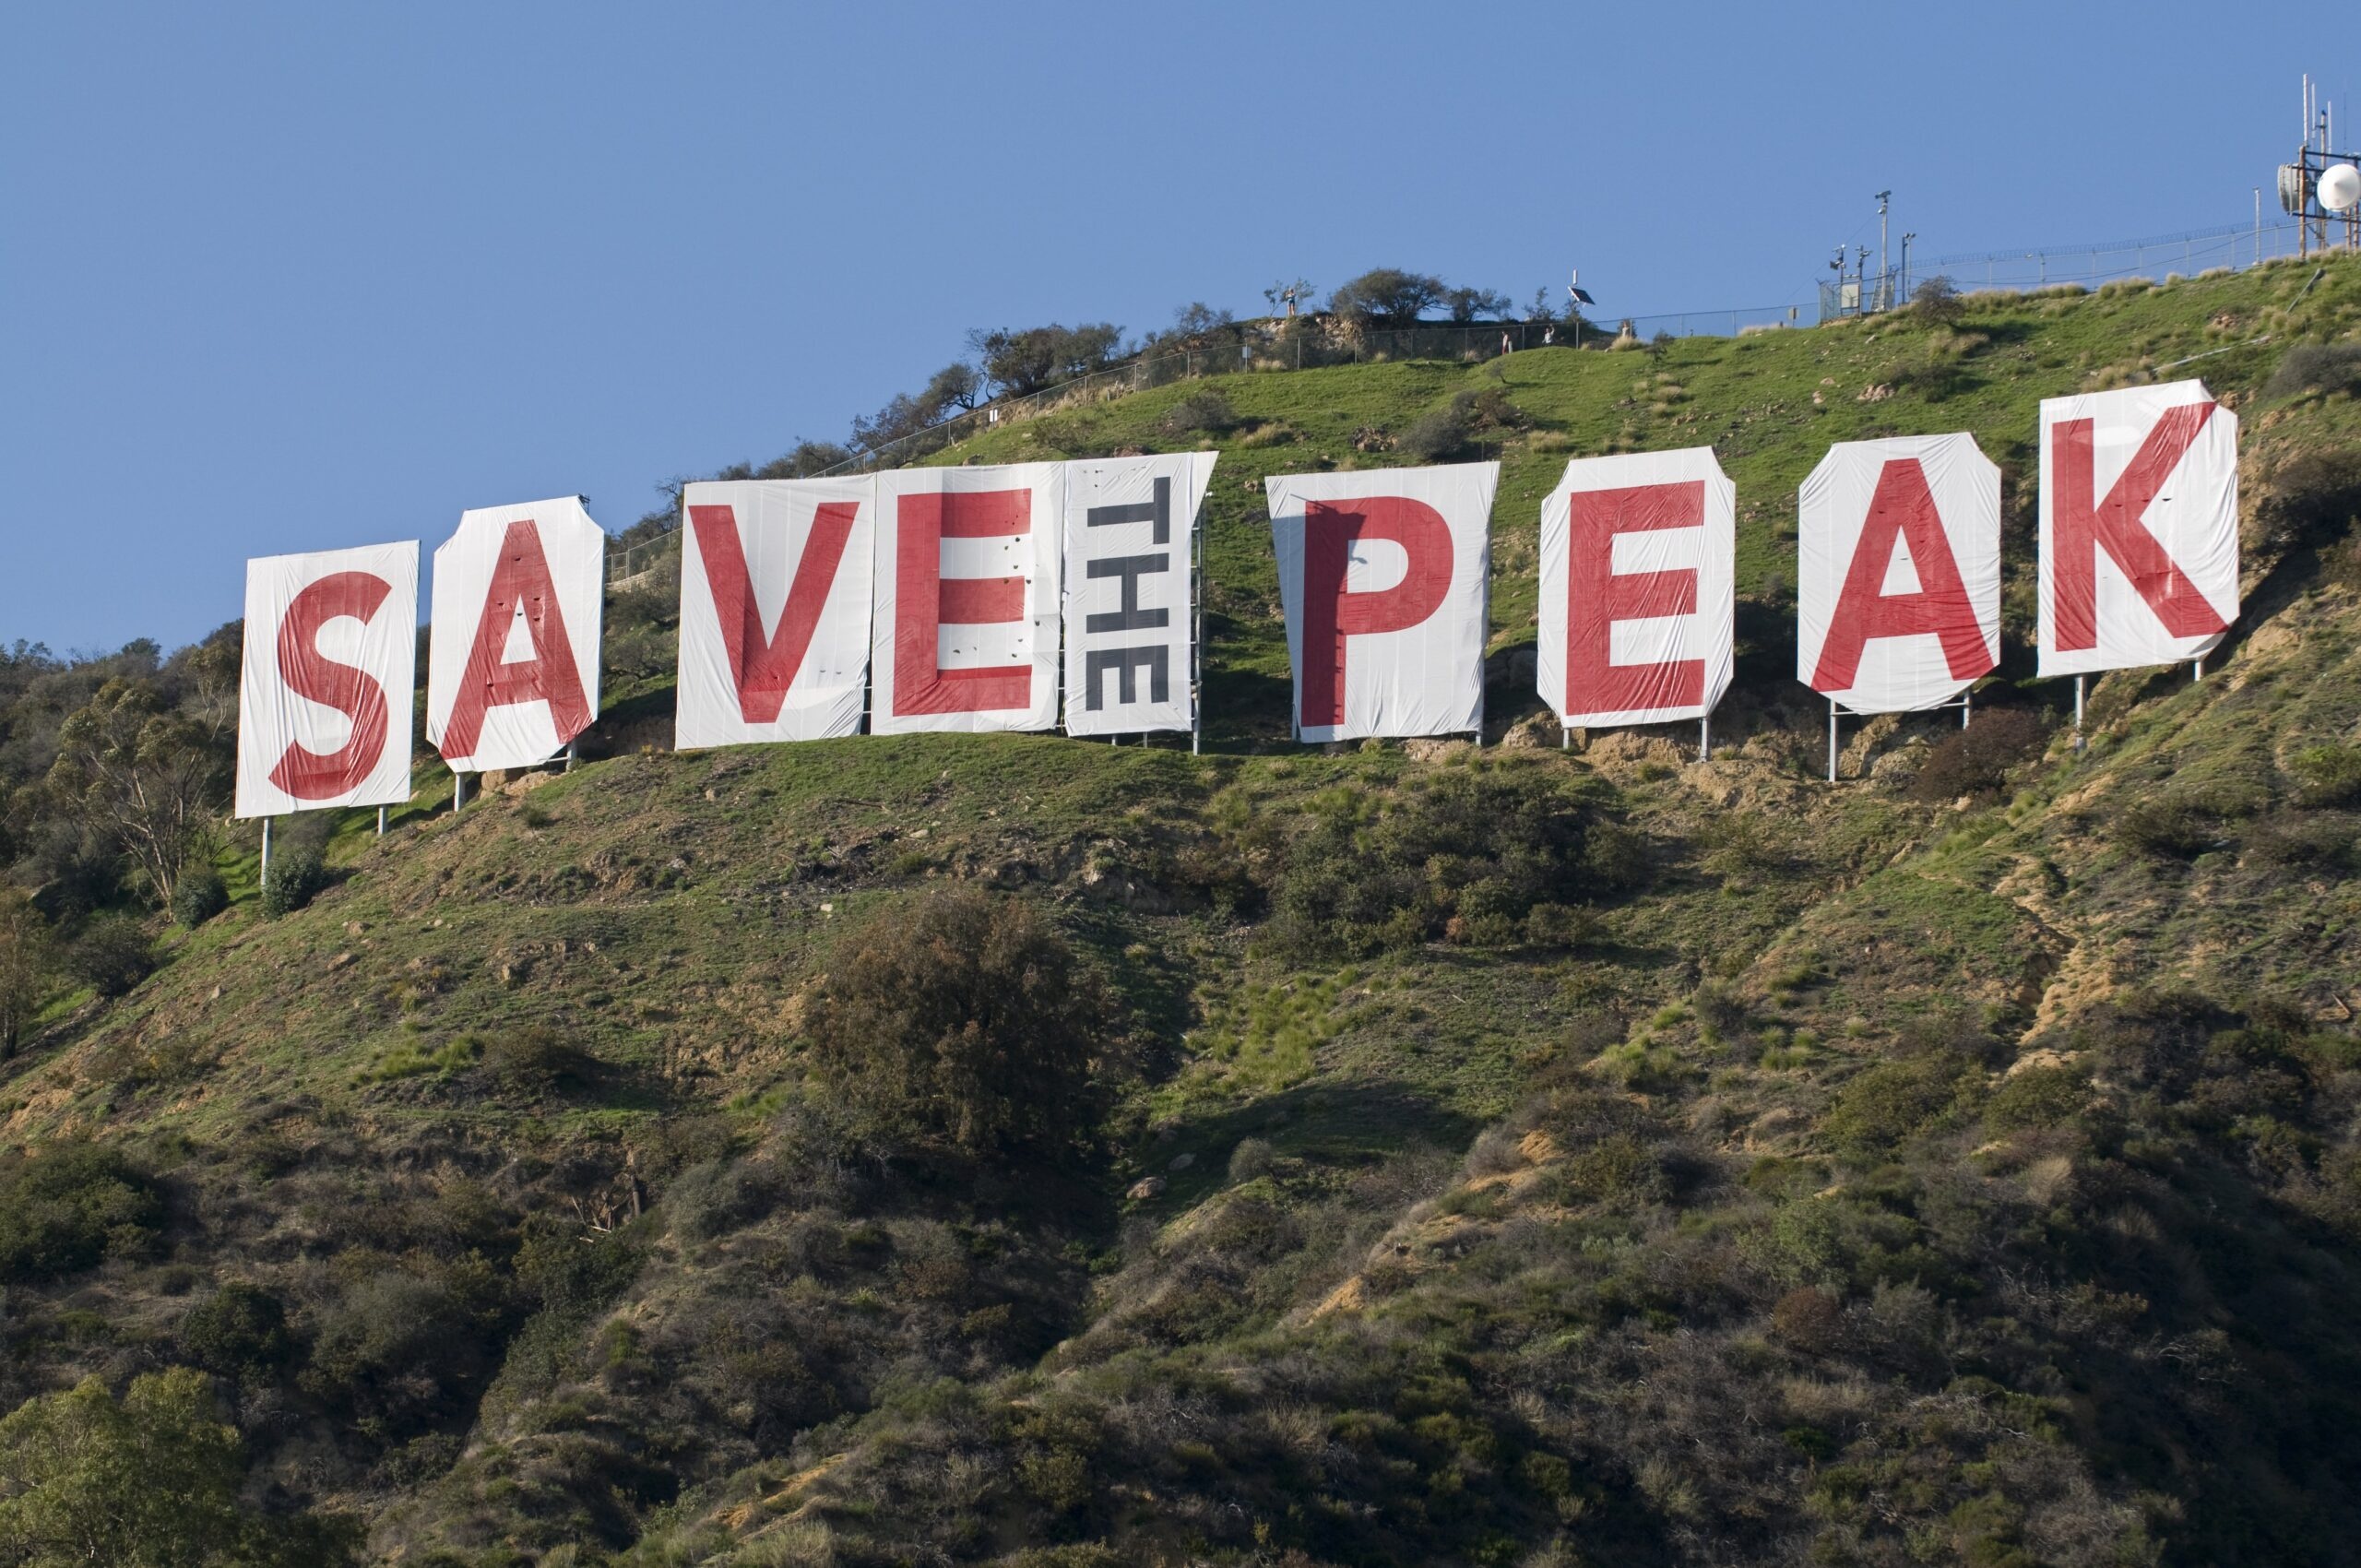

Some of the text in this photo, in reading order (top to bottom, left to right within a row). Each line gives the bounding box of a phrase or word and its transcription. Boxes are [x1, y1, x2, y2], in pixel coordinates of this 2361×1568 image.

[268, 401, 2230, 801] SAVE THE PEAK
